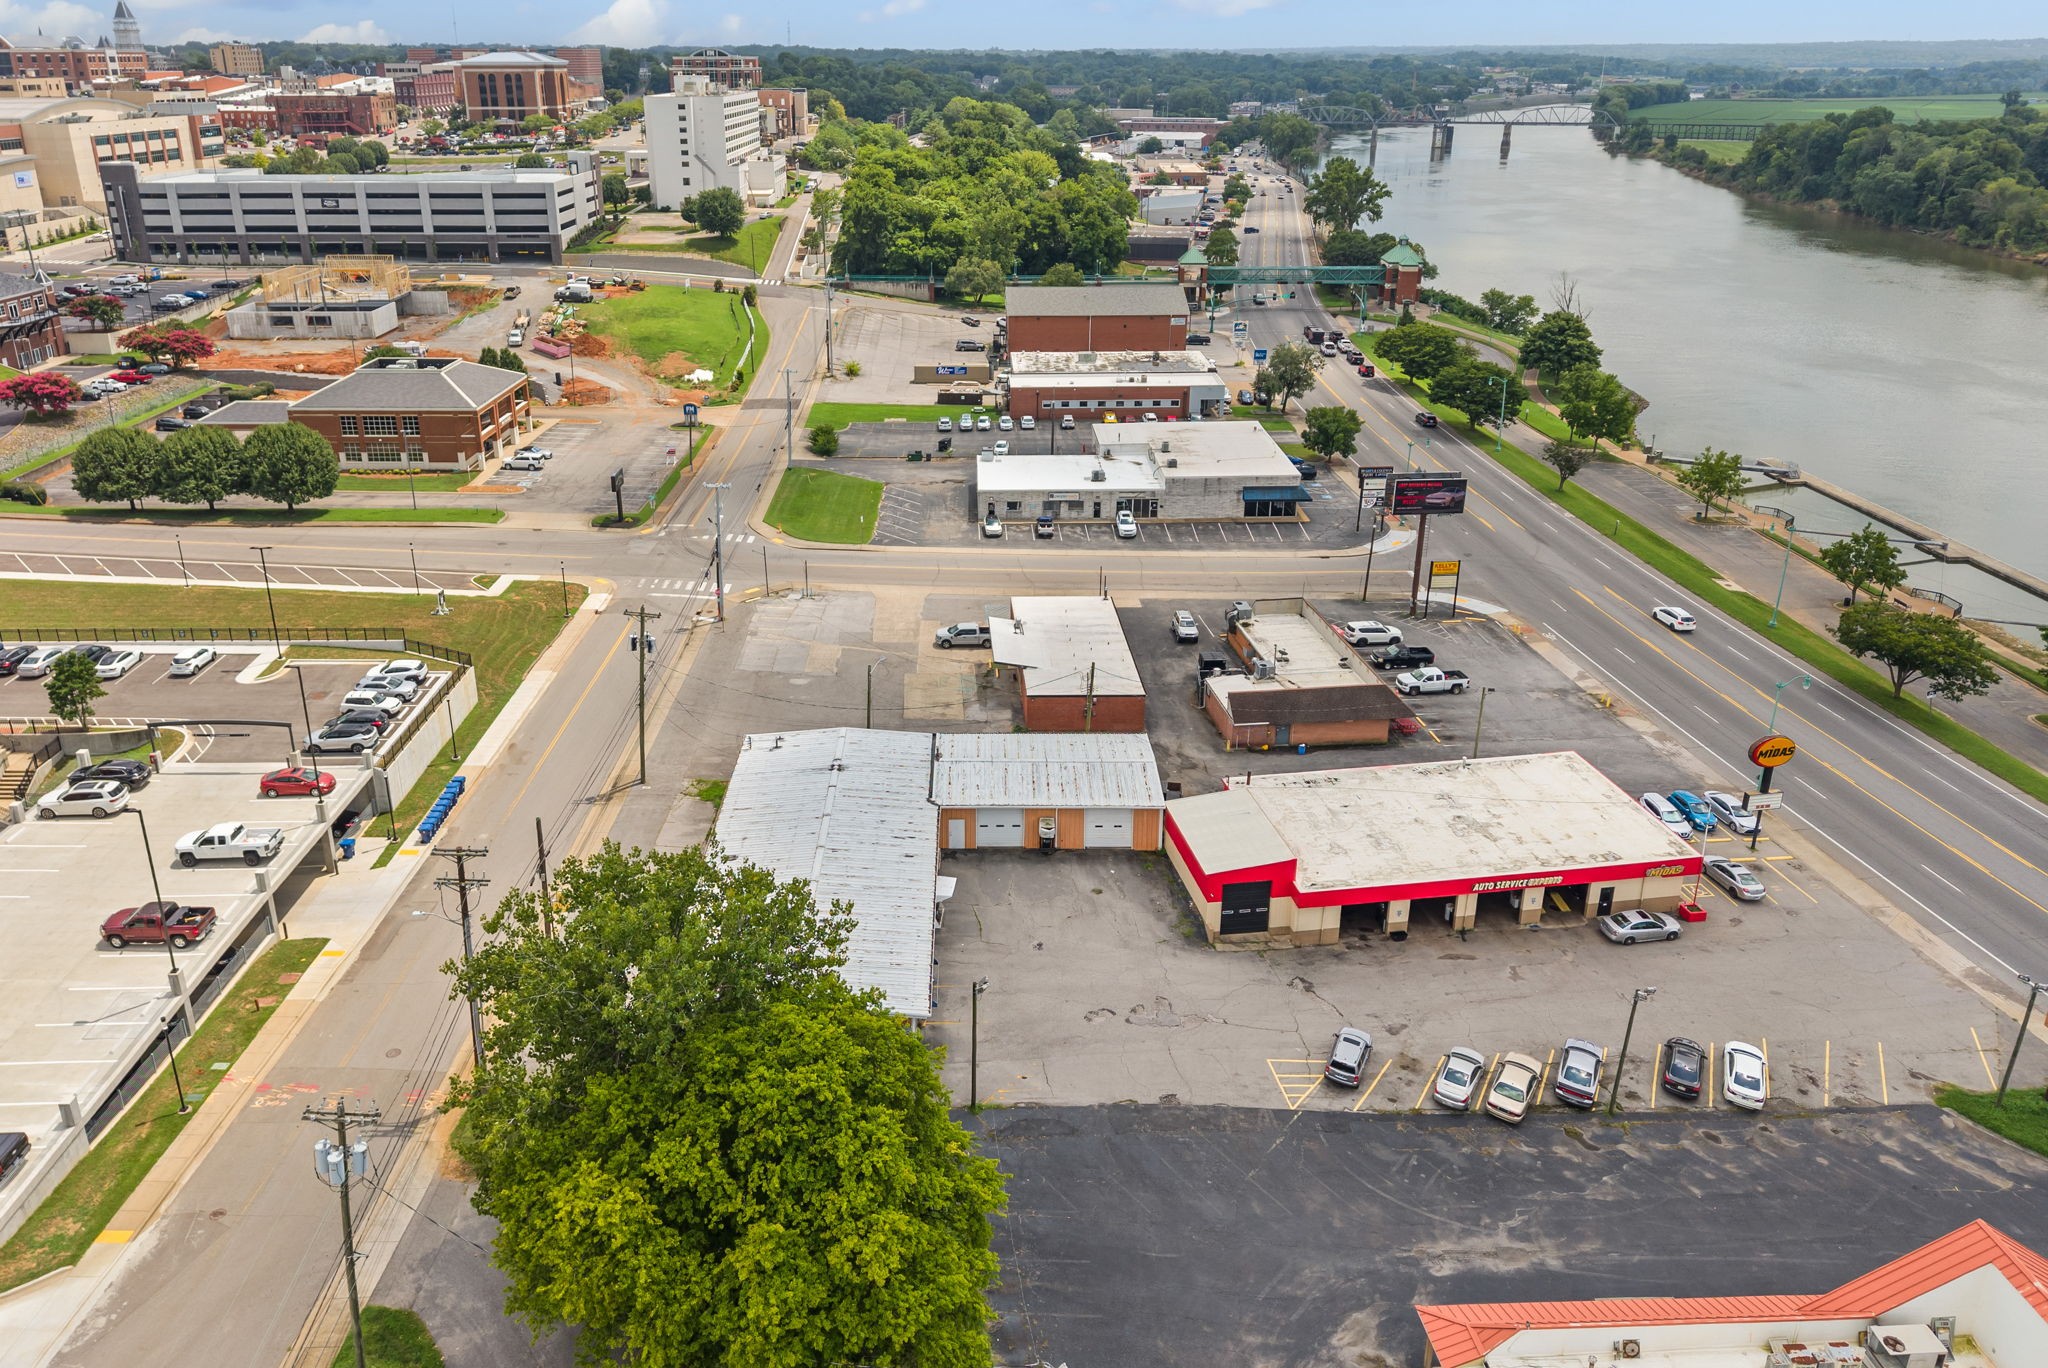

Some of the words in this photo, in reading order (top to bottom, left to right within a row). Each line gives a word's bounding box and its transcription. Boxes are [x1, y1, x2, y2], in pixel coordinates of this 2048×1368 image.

[1758, 746, 1795, 760] MIDAS
[1648, 865, 1684, 877] MIDAS
[1473, 883, 1494, 891] AUTO
[1496, 880, 1528, 889] SERVICE
[1528, 876, 1563, 886] EXPERTS
